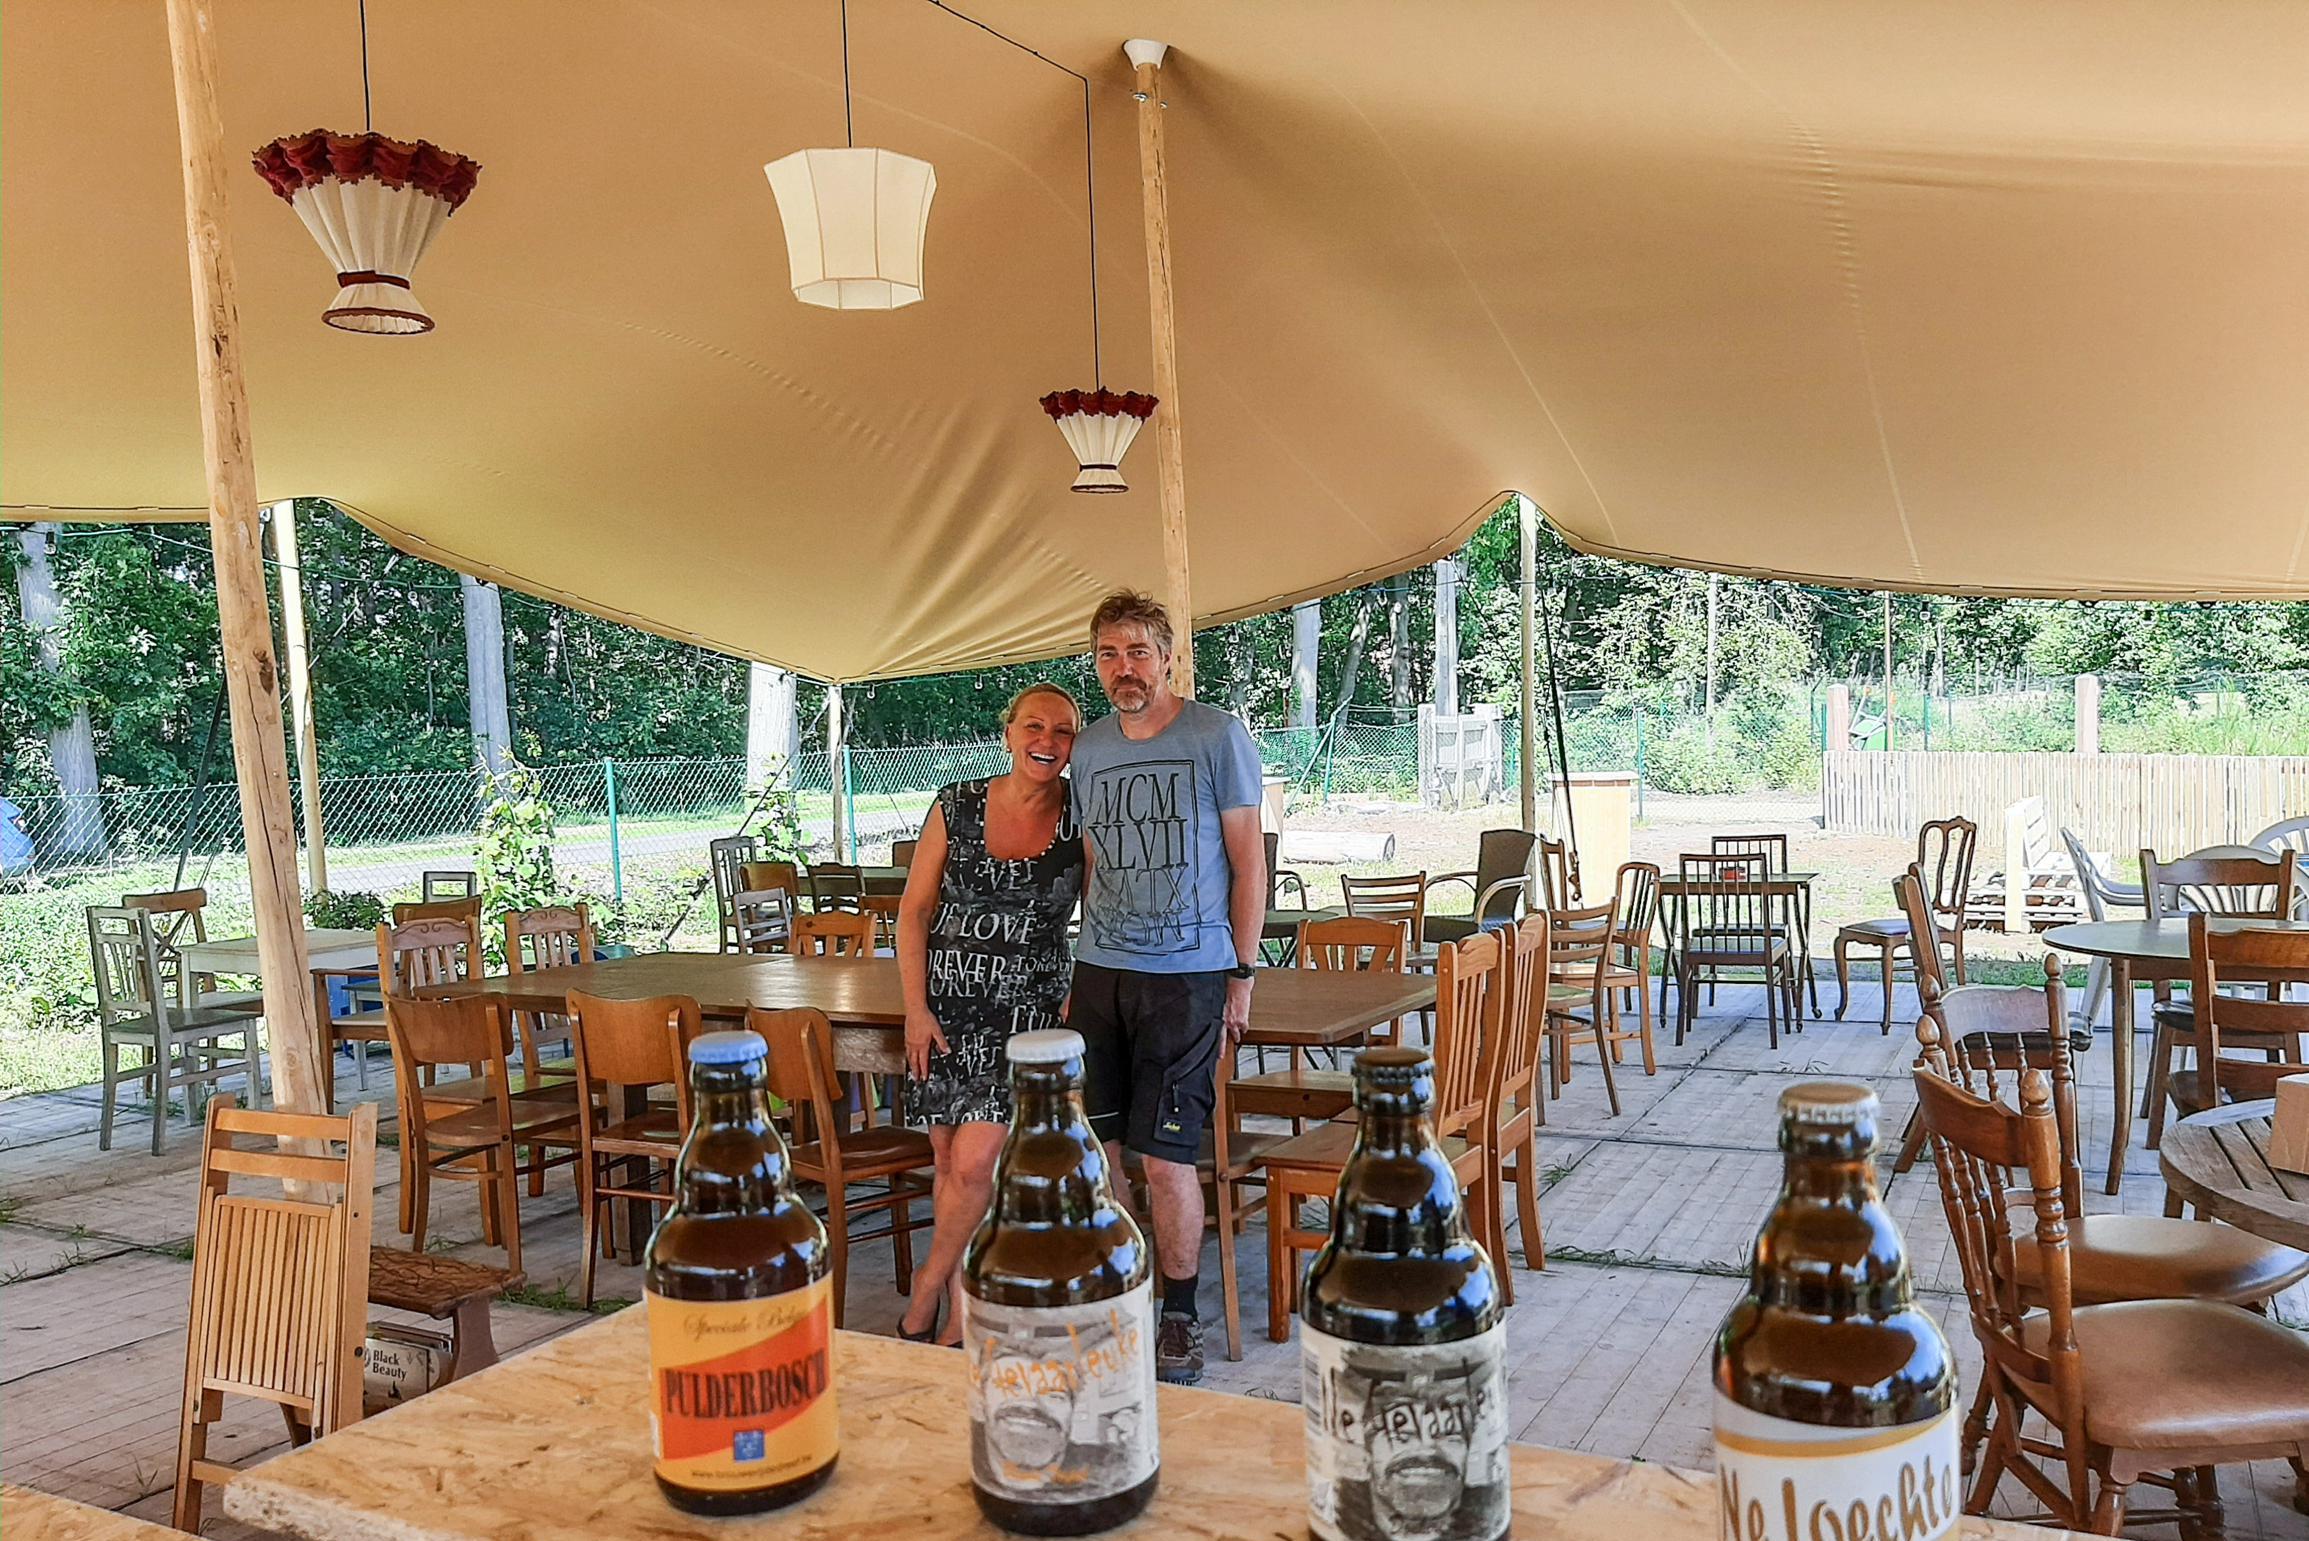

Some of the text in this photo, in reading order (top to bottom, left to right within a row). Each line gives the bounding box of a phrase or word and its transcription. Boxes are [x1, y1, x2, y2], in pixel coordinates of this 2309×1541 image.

[1092, 772, 1181, 826] MCM
[1088, 817, 1190, 871] XLVII
[372, 1362, 407, 1382] Beauty
[373, 1349, 400, 1366] Black
